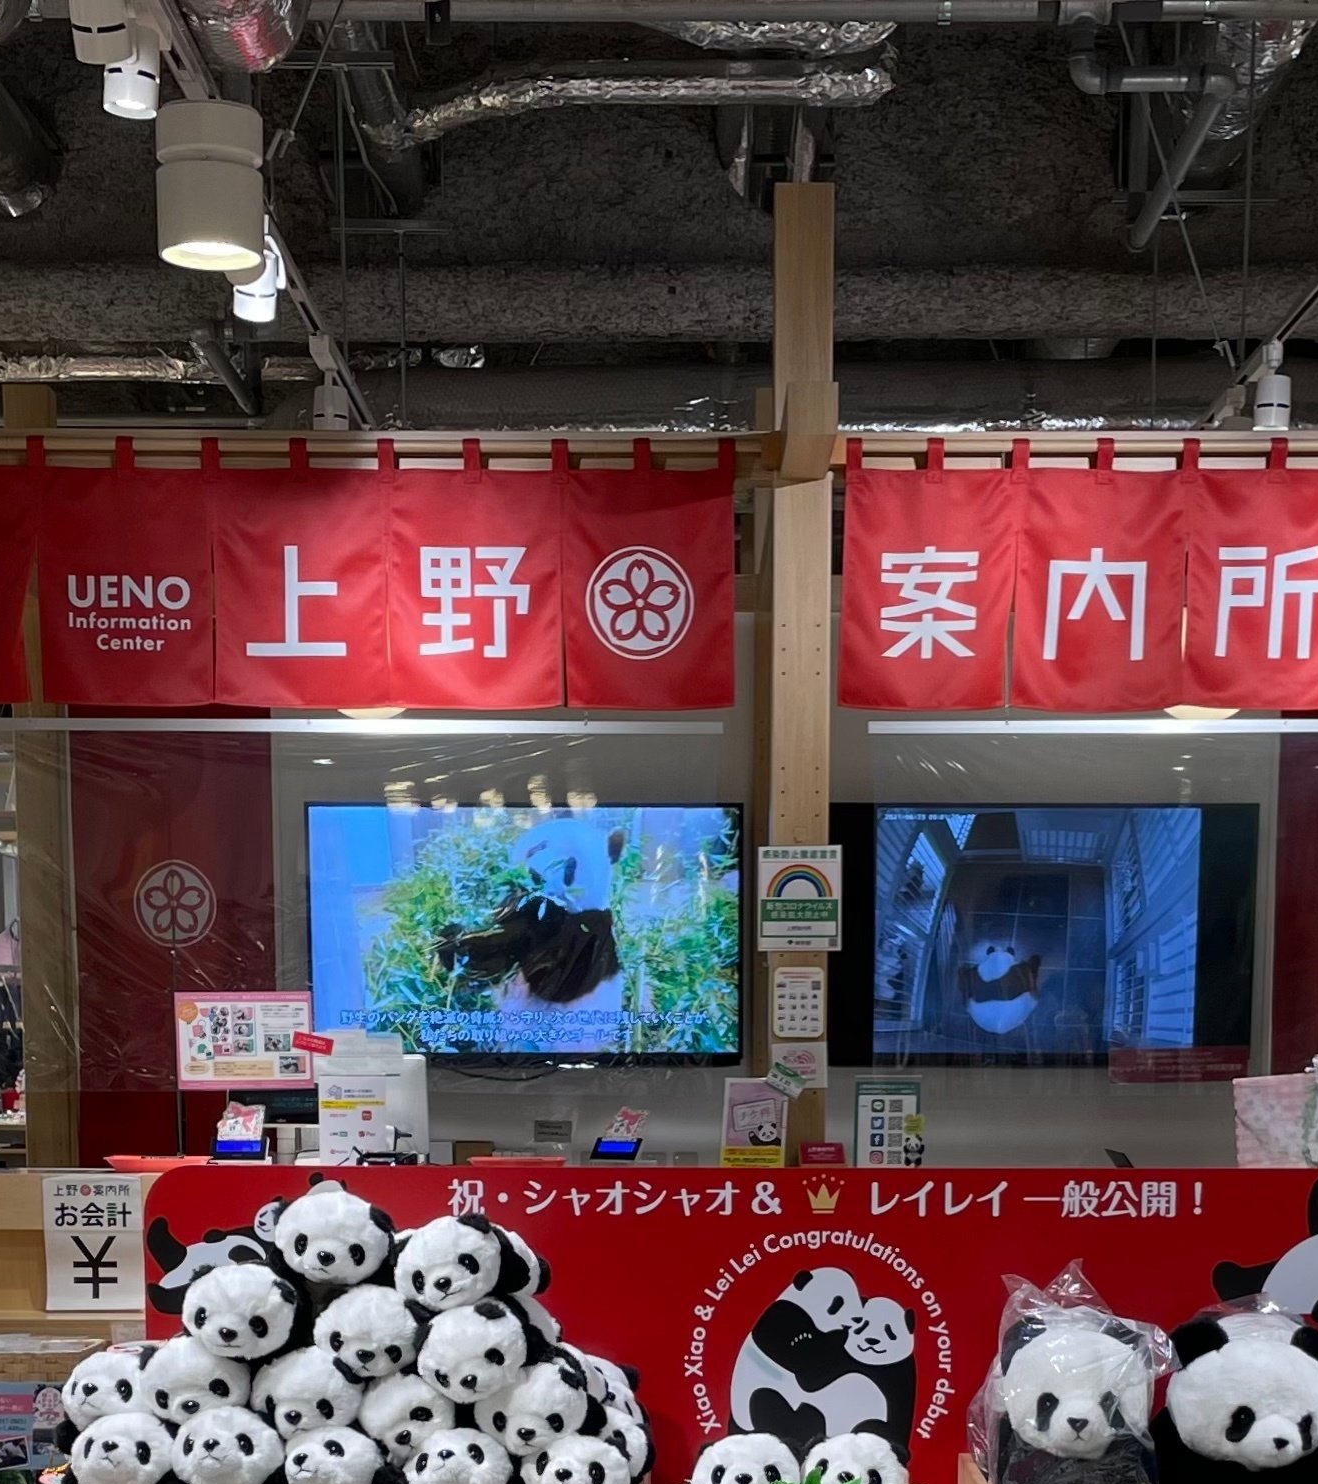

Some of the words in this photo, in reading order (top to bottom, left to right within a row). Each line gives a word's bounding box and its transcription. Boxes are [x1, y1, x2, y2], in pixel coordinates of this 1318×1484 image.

[68, 575, 190, 610] UENO
[247, 545, 531, 659] 上野
[68, 612, 191, 631] Information
[97, 634, 165, 652] Center
[54, 1201, 132, 1228] お会計
[751, 1181, 782, 1215] &
[870, 1181, 1009, 1217] レイレイ
[729, 1242, 762, 1274] Lei
[763, 1229, 926, 1290] Congratulations
[703, 1268, 735, 1301] Lei
[921, 1290, 943, 1319] on
[684, 1326, 707, 1378] Xiao
[928, 1321, 952, 1373] your
[692, 1382, 722, 1435] Xiao
[916, 1378, 956, 1440] debut
